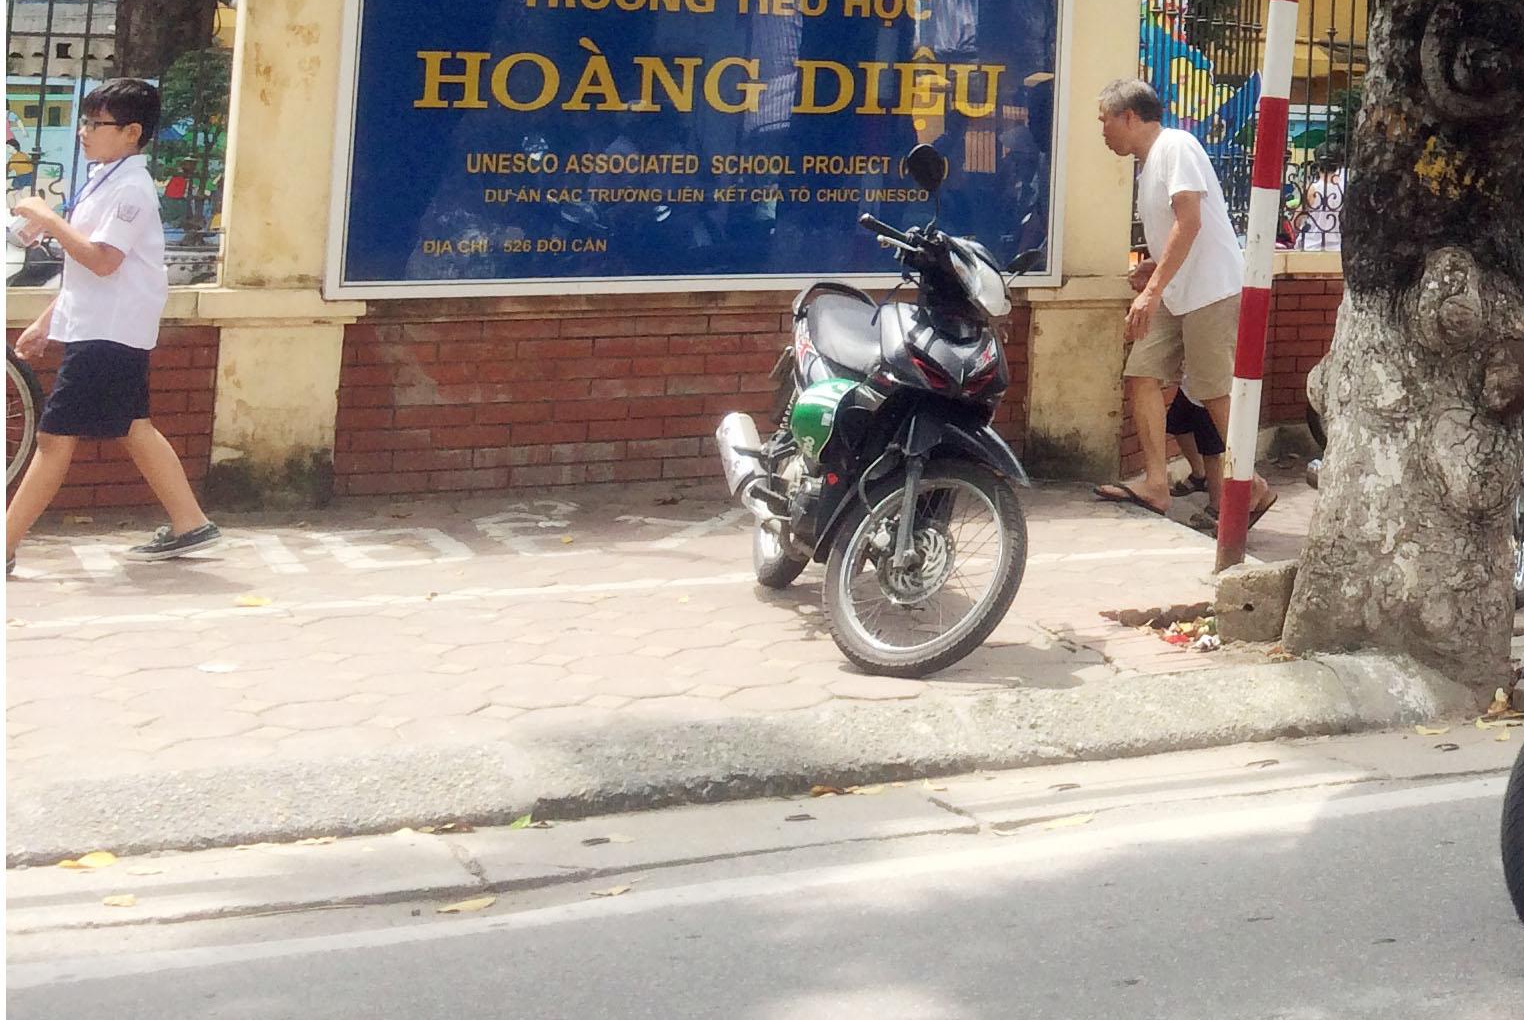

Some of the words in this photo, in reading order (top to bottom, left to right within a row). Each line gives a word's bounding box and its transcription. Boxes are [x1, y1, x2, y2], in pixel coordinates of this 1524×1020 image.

[413, 36, 767, 114] HOÀNG
[793, 47, 1006, 131] DIỆU
[467, 153, 558, 174] UNESCO
[565, 154, 699, 175] ASSOCIATED
[711, 155, 795, 175] SCHOOL
[802, 155, 891, 175] PROJECT
[588, 185, 662, 203] TRƯỜNG
[865, 188, 929, 203] UNESCO
[503, 239, 531, 252] 526
